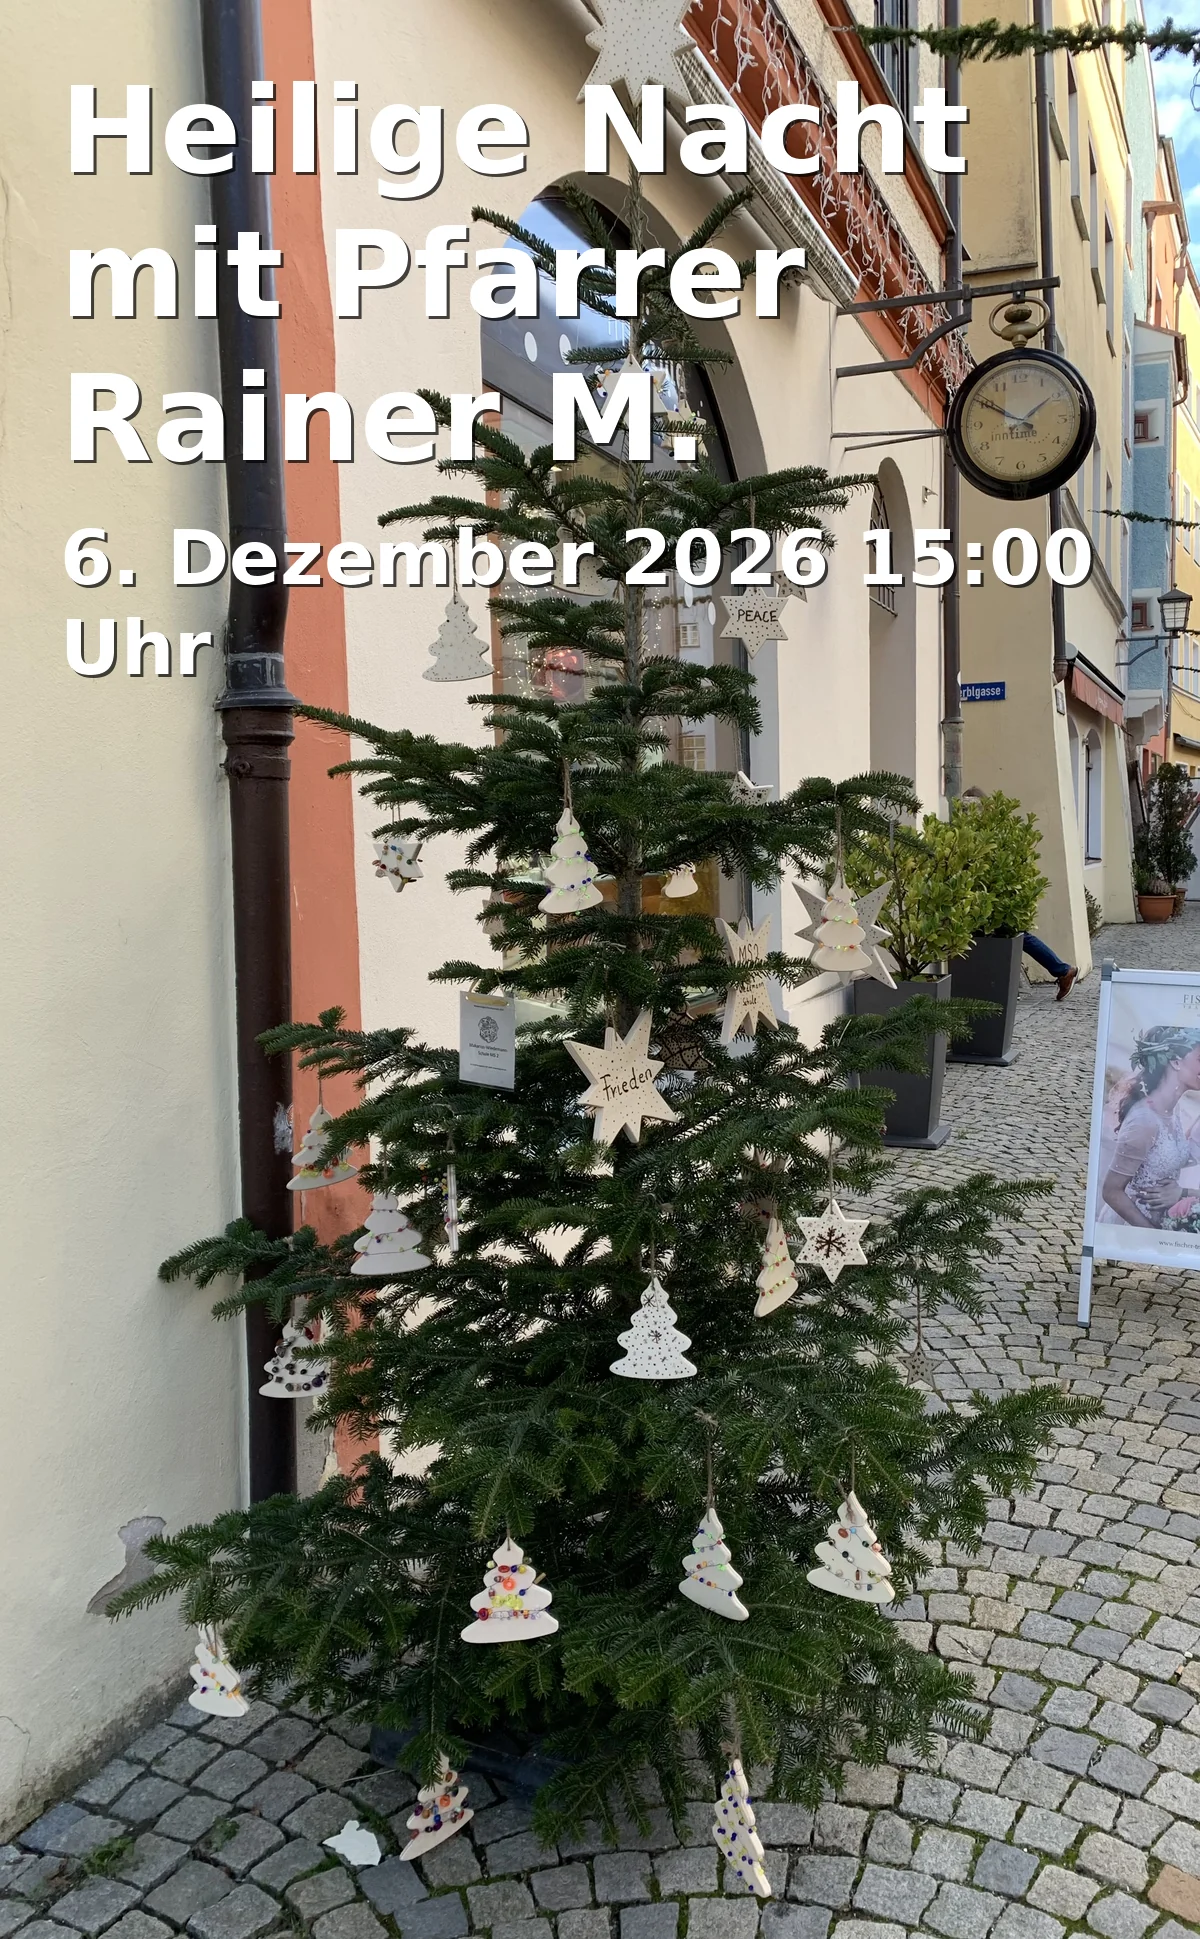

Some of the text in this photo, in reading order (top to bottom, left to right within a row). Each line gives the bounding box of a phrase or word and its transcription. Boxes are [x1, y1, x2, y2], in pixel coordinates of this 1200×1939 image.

[994, 382, 1007, 393] 11
[973, 420, 984, 431] 9
[990, 429, 1038, 442] inntime
[1051, 435, 1061, 445] 4
[979, 441, 990, 451] 8
[994, 456, 1005, 466] 7
[1036, 452, 1047, 463] 5
[1015, 460, 1026, 471] 6
[736, 608, 779, 623] PEACE
[600, 1067, 653, 1101] Frieden
